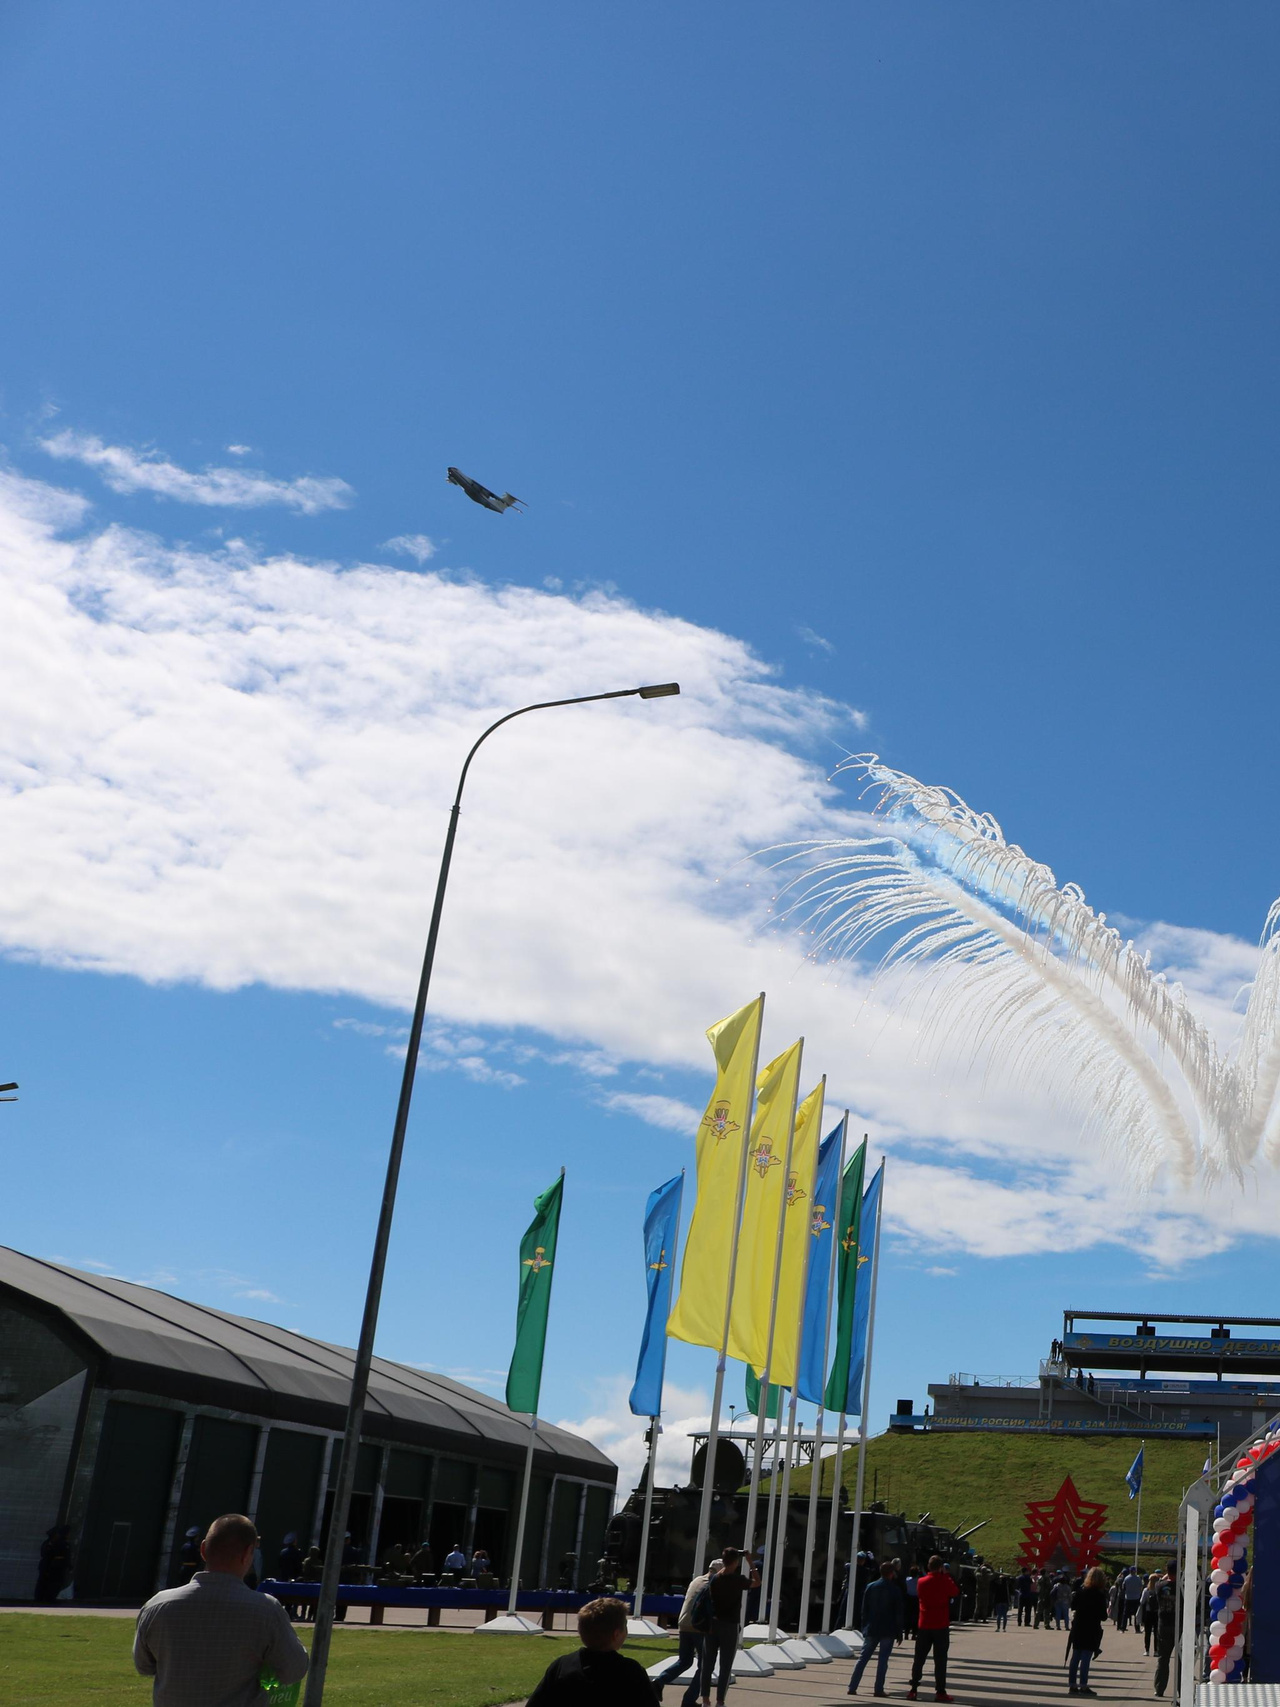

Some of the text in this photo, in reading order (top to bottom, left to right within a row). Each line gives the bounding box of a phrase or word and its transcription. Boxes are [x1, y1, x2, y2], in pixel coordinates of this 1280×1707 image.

[924, 1416, 978, 1426] ГРАНИЦЫ
[981, 1417, 1025, 1427] РОССИИ
[1067, 1420, 1082, 1429] НЕ
[1085, 1420, 1187, 1431] ЗАКАНЧИВАЮТСЯ!
[1141, 1534, 1178, 1544] НИКТ
